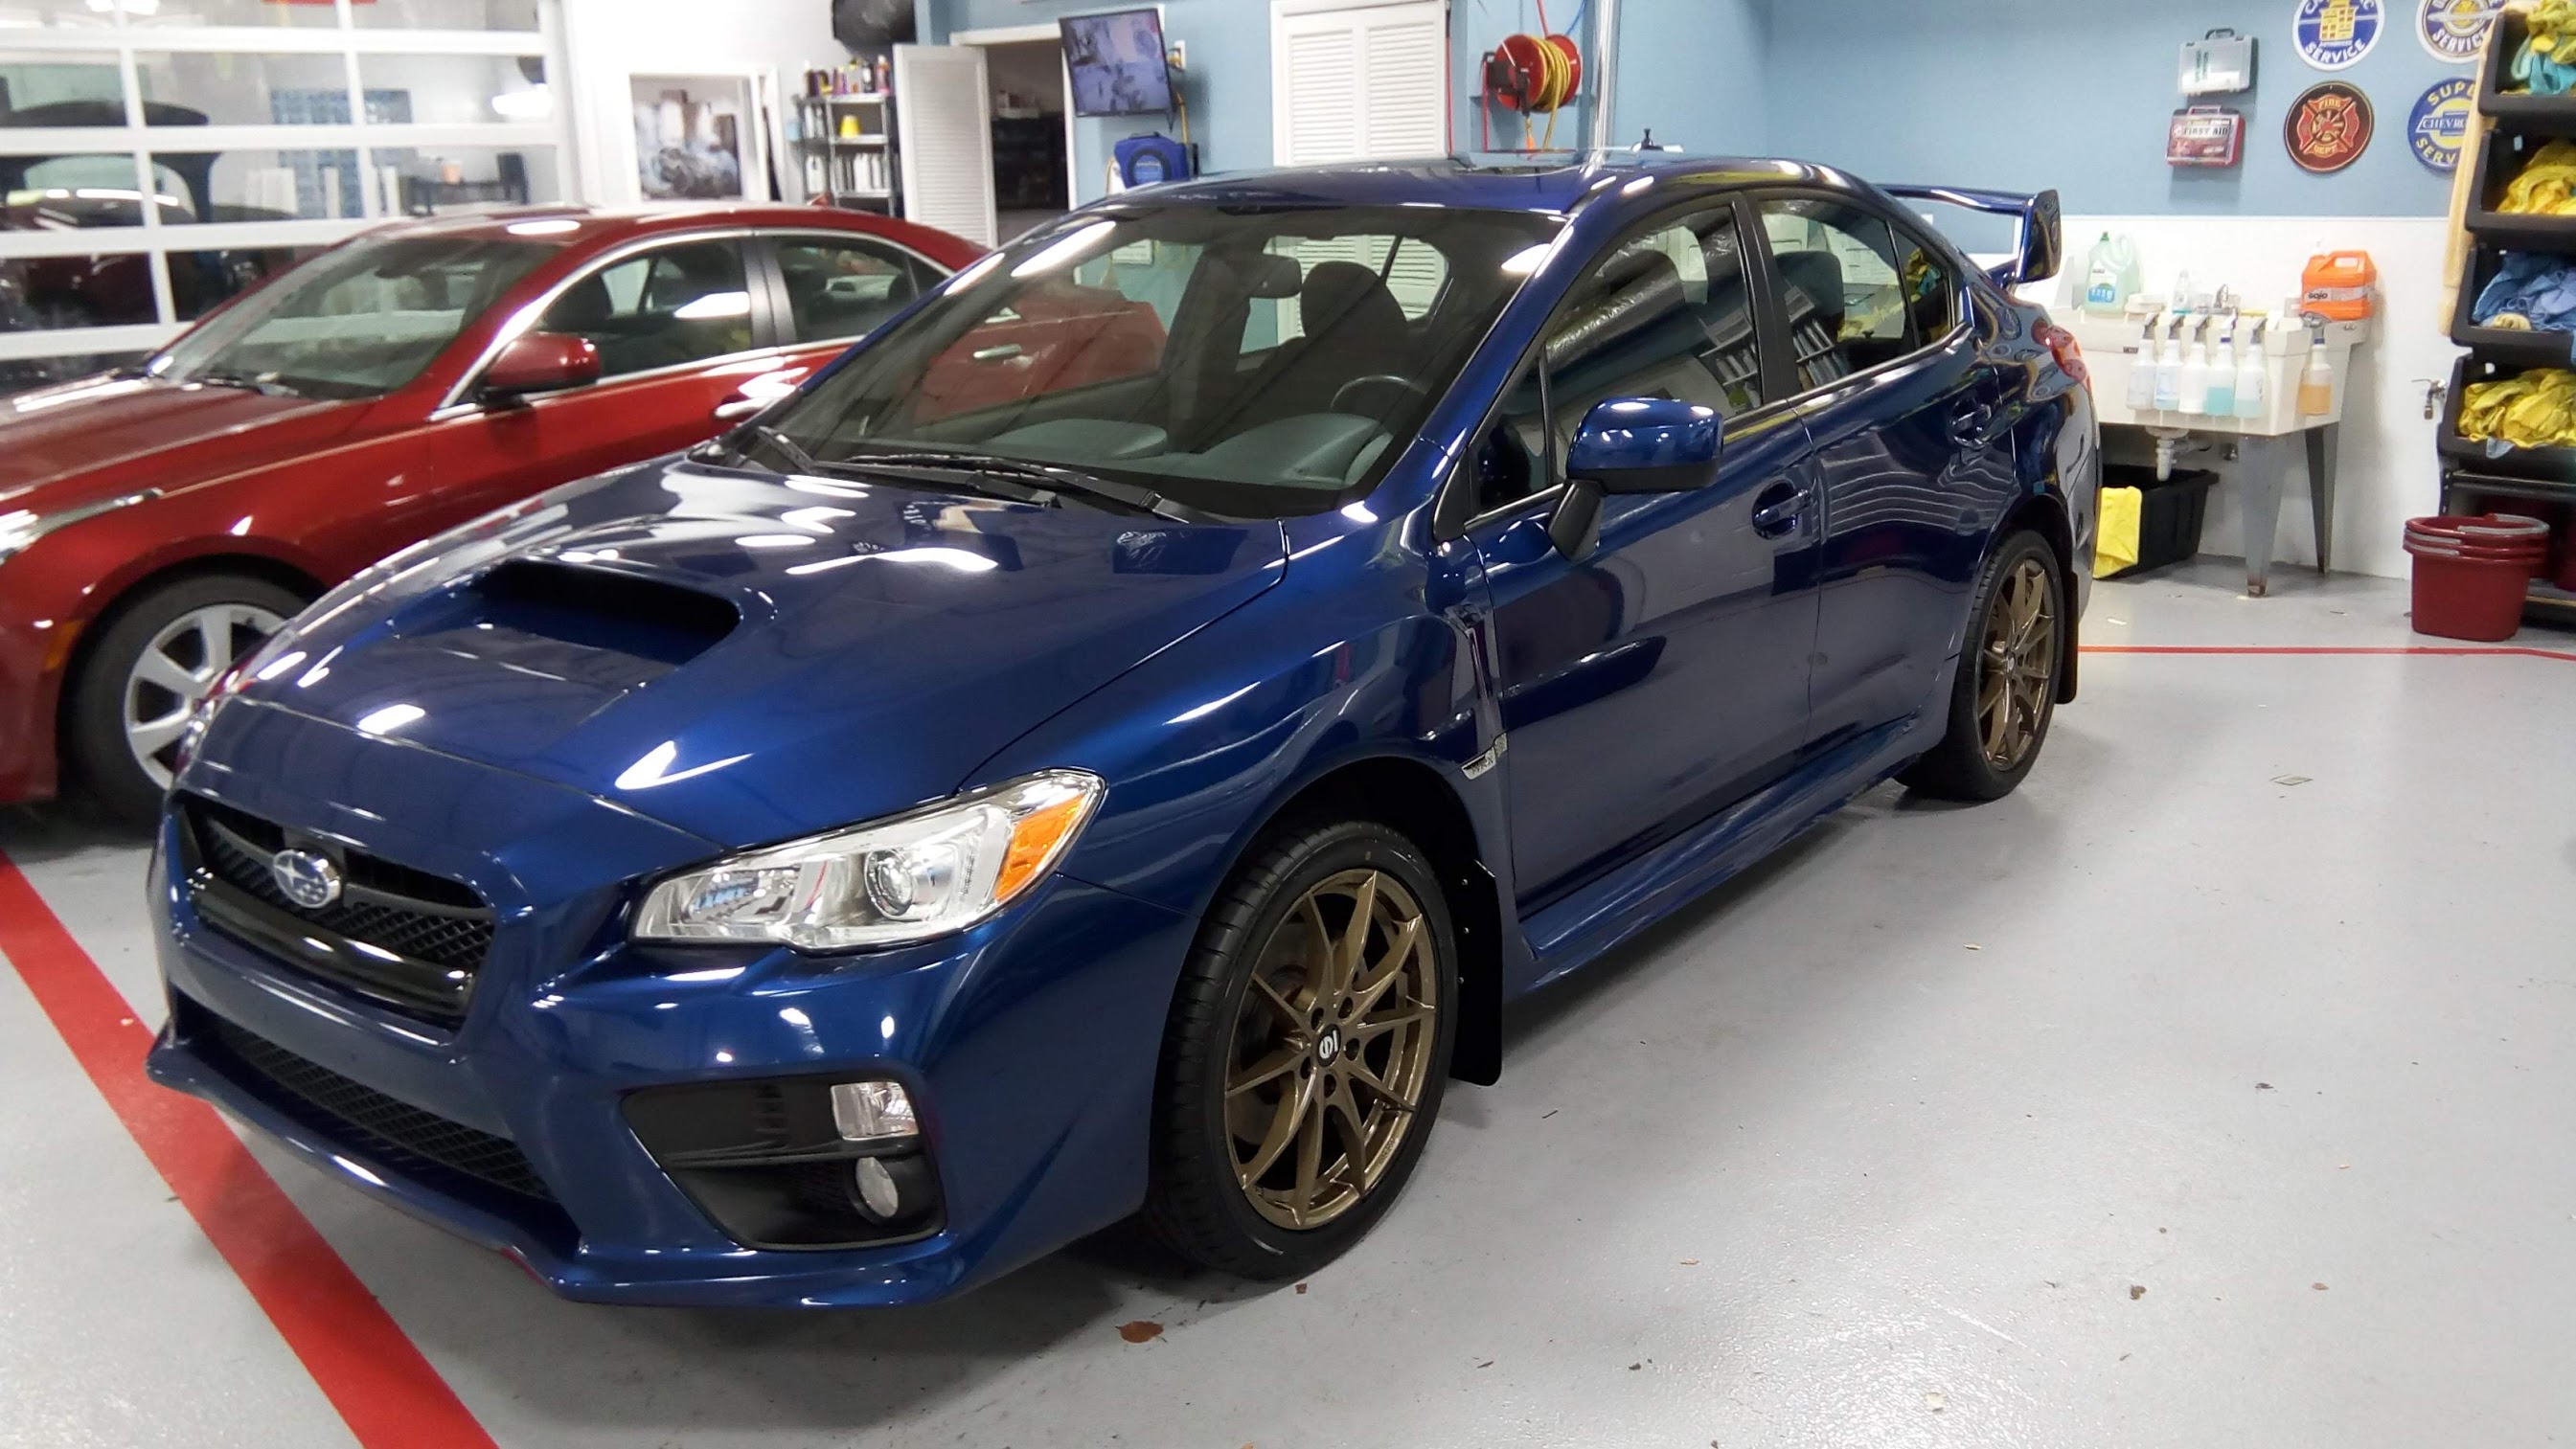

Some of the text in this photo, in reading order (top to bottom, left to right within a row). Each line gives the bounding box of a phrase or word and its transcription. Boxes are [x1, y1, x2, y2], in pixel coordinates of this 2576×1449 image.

[2305, 38, 2365, 63] SERVICE
[2183, 125, 2228, 135] FIRST AID
